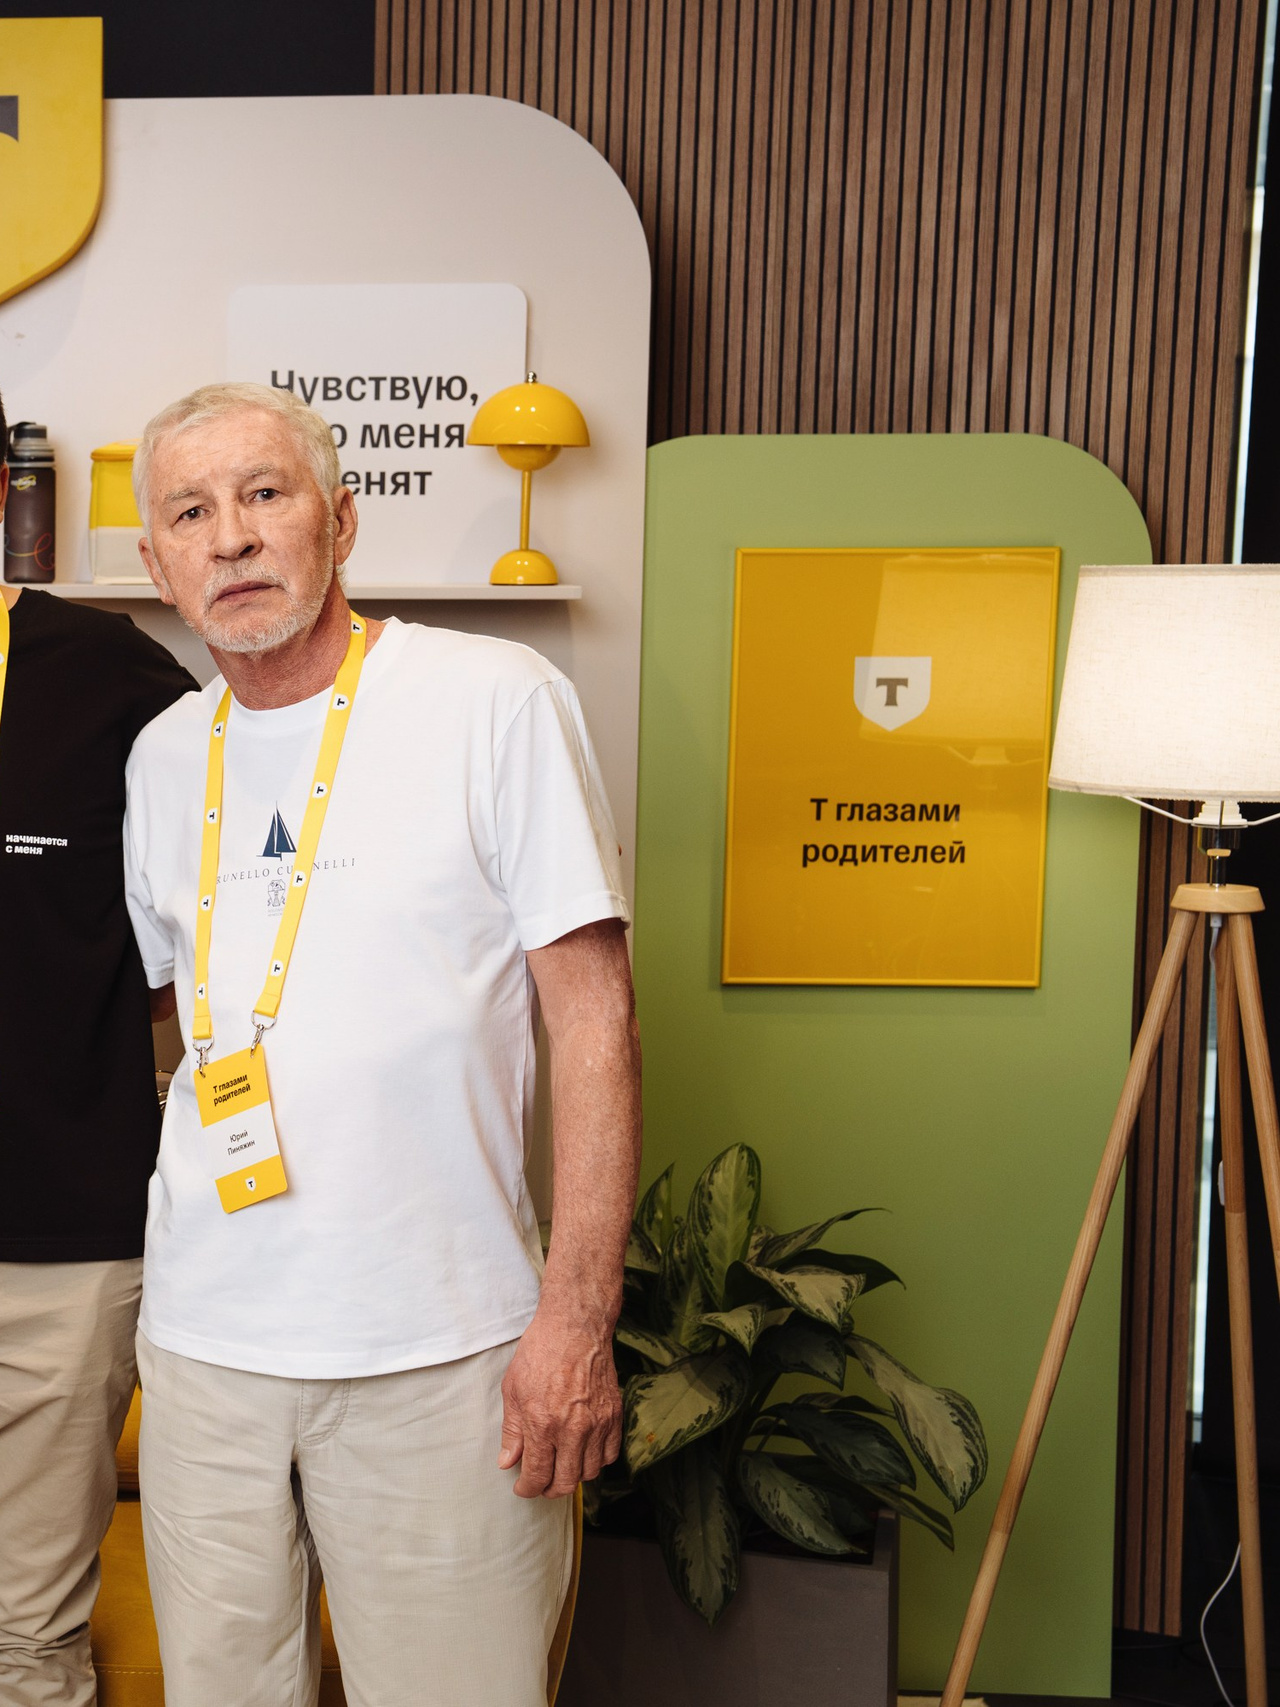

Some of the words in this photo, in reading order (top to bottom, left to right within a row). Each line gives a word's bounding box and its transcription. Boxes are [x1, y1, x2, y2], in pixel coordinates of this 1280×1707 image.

[271, 370, 478, 408] Чувствую,
[361, 423, 465, 449] меня
[341, 470, 432, 496] енят
[810, 799, 828, 821] Т
[836, 803, 960, 822] глазами
[5, 845, 13, 854] с
[14, 845, 43, 855] меня
[6, 834, 68, 847] начинается
[802, 841, 966, 868] родителей
[216, 868, 270, 884] RUNELLO
[277, 858, 355, 876] CUNELLI
[213, 1083, 251, 1106] родителей
[219, 1074, 248, 1092] глазами
[230, 1130, 248, 1143] Юрий
